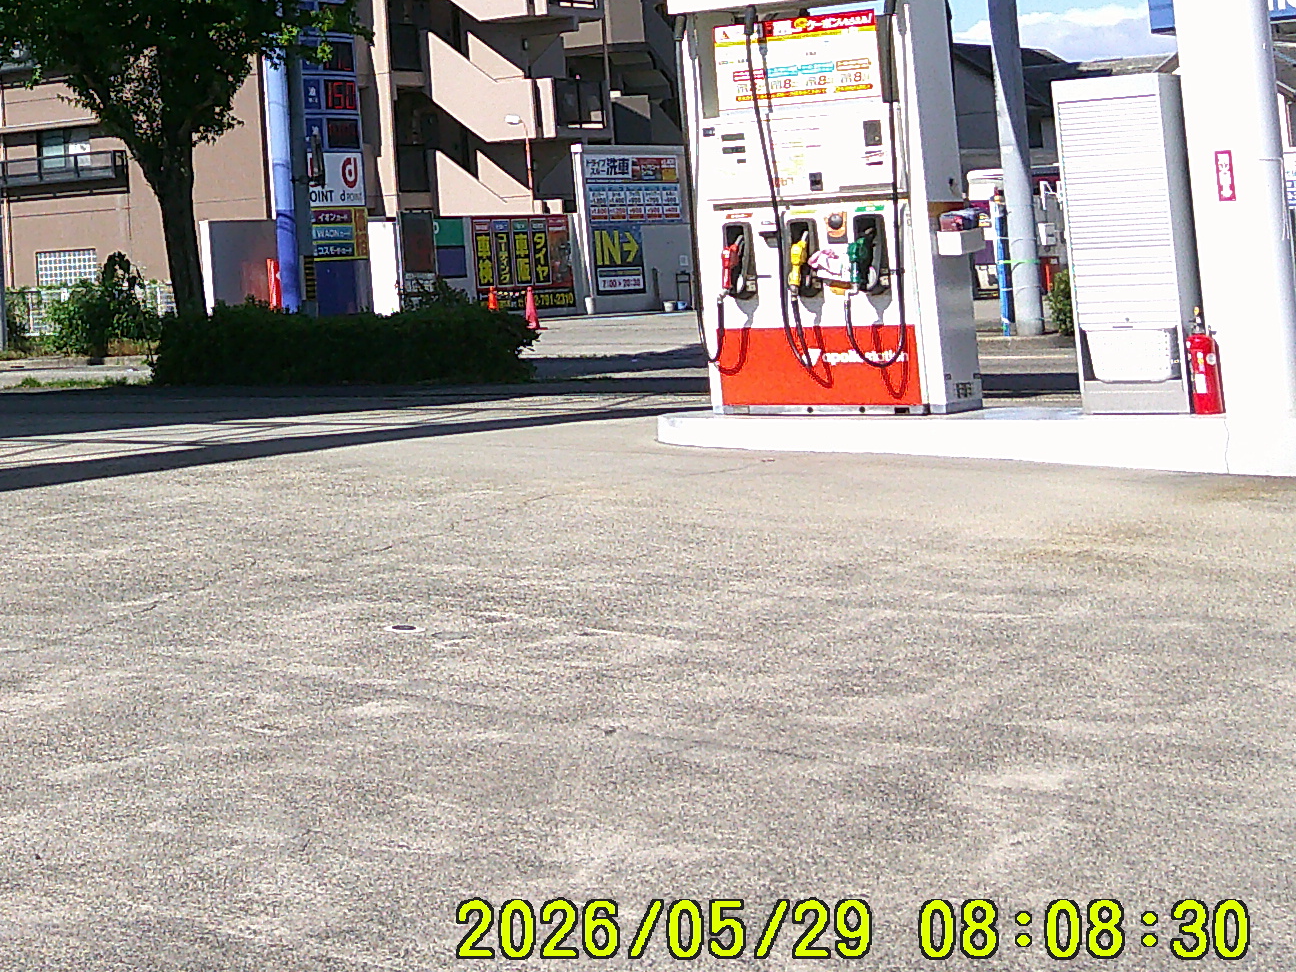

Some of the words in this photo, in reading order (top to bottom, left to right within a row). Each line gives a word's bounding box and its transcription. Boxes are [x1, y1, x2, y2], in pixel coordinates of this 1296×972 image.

[328, 82, 355, 109] 150
[606, 158, 630, 175] 洗車
[310, 190, 334, 202] OINT
[476, 234, 494, 285] 車検
[497, 234, 511, 283] コーティング
[533, 233, 549, 281] タイヤ
[594, 230, 621, 265] IN
